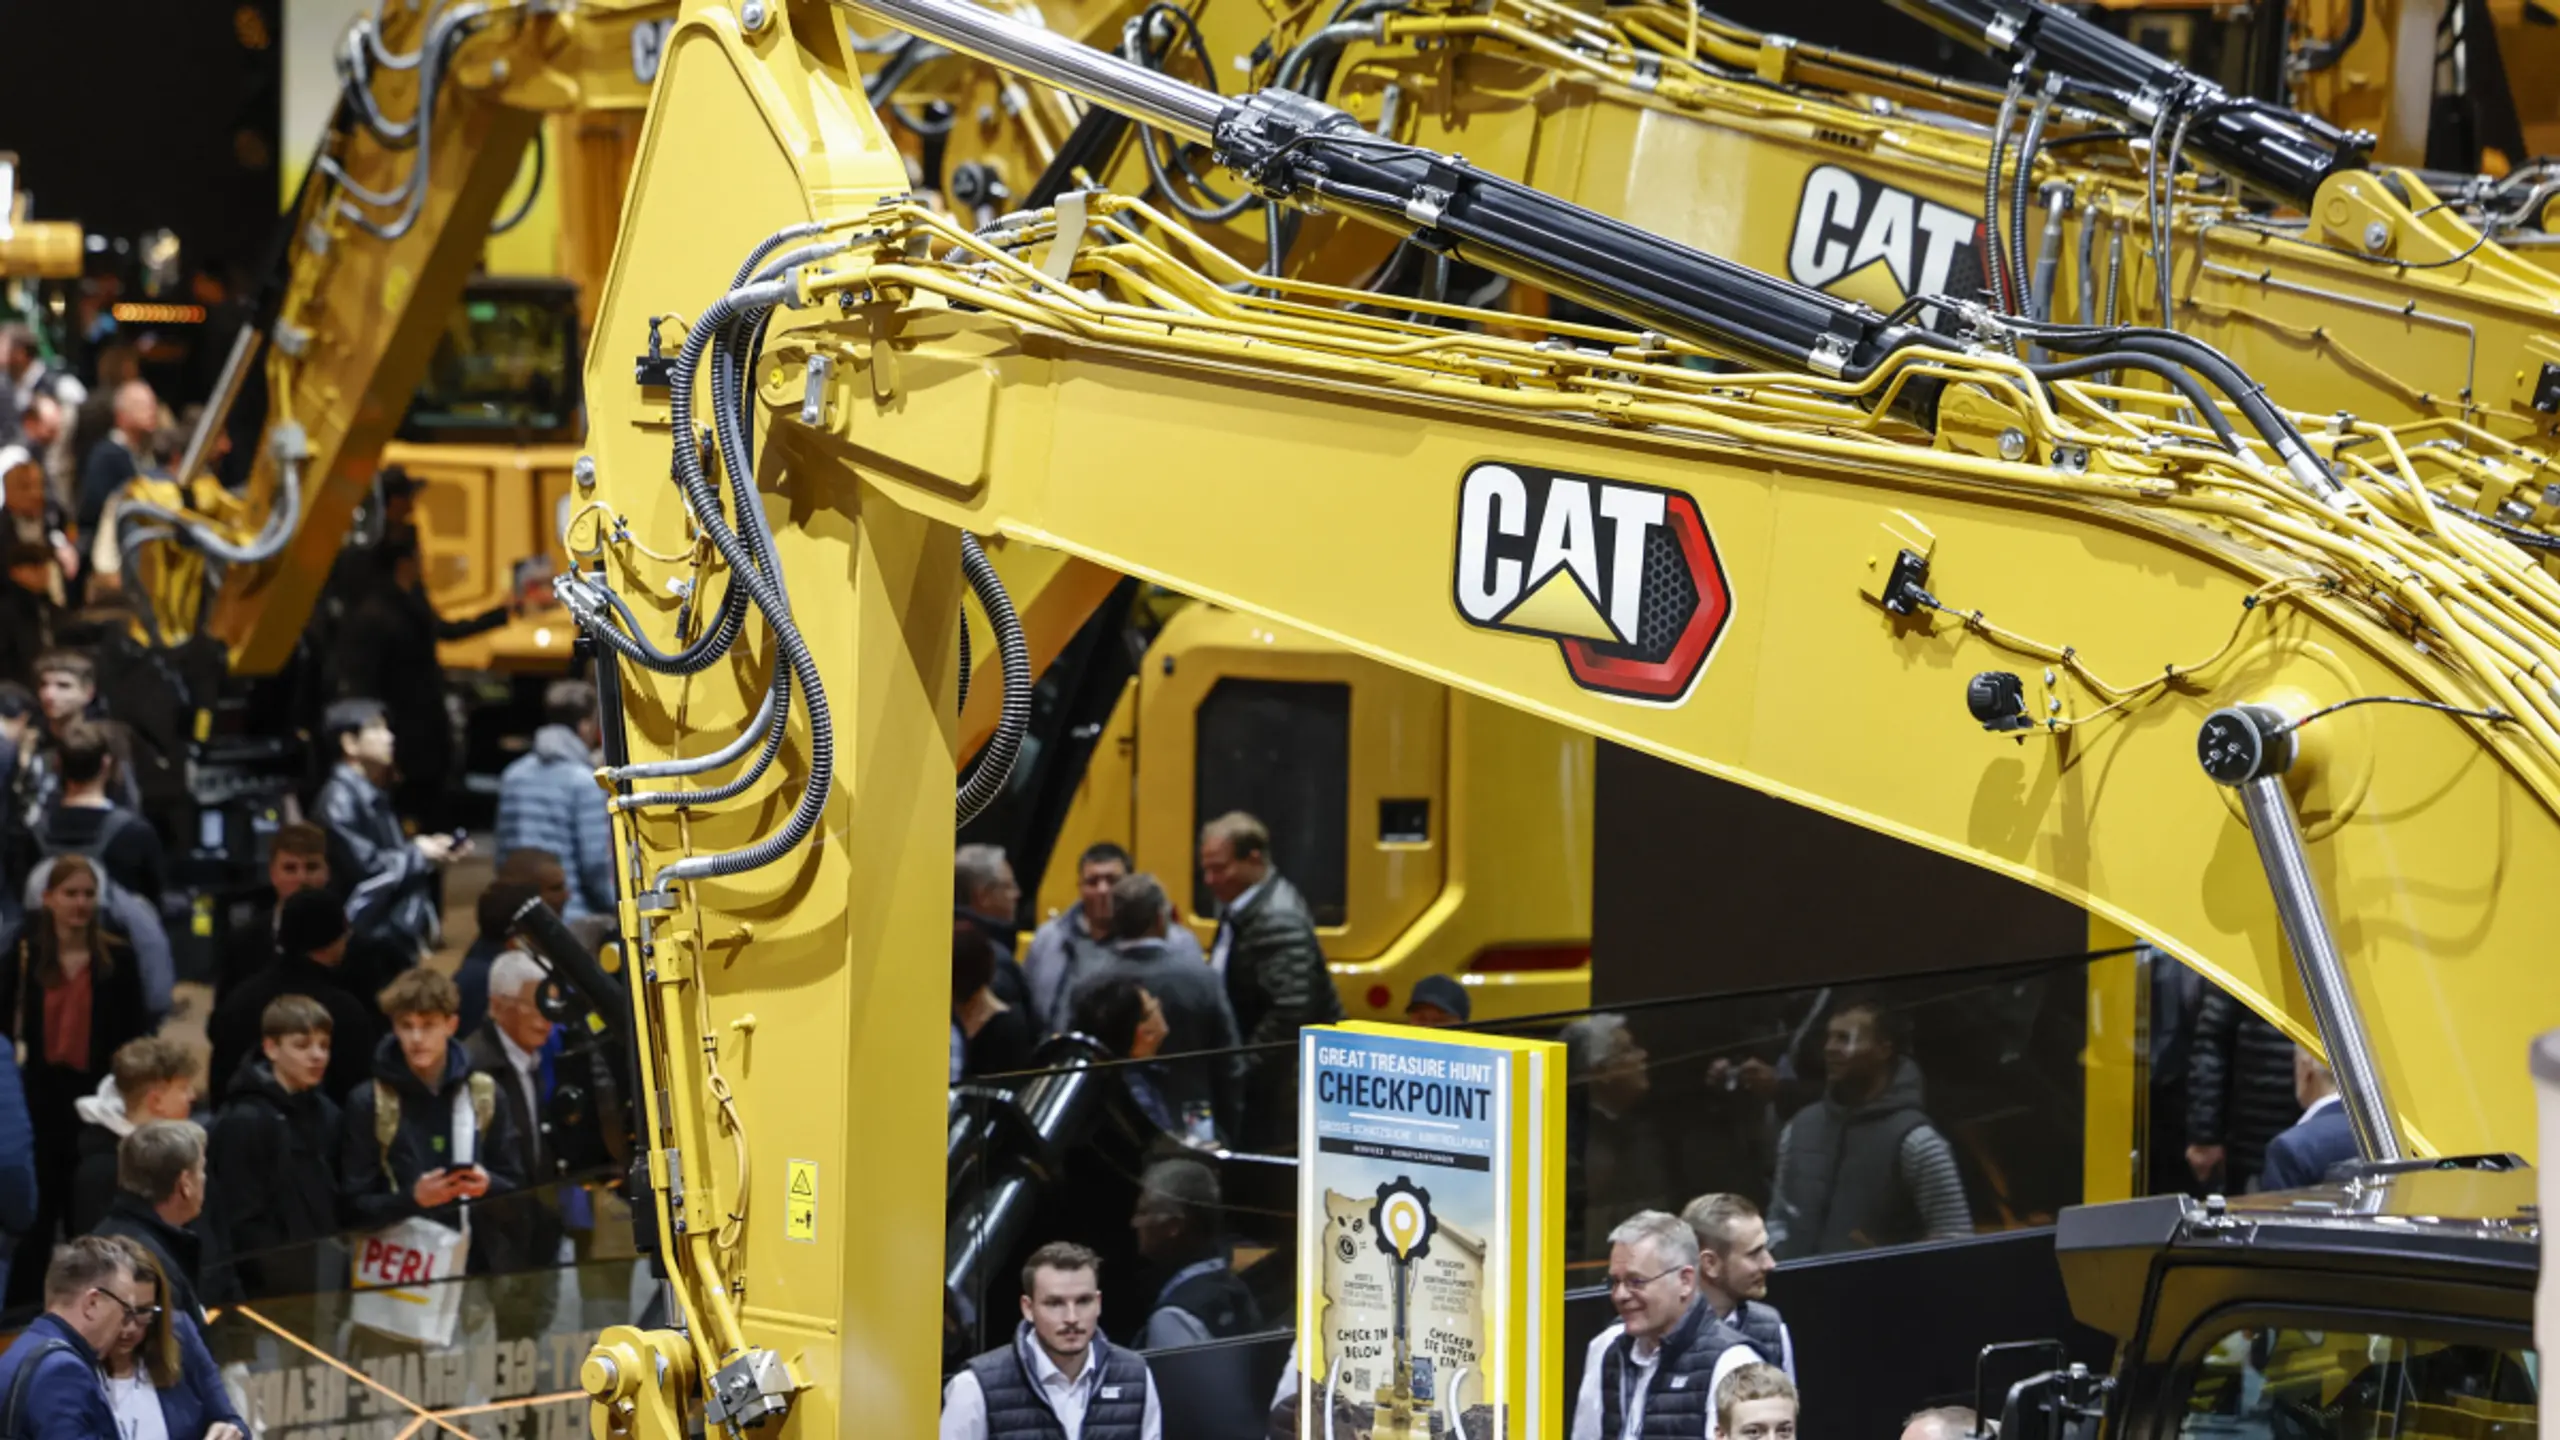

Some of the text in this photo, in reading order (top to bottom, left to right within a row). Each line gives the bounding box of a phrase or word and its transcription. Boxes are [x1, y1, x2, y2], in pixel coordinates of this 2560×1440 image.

[1790, 165, 1977, 330] CAT
[1458, 465, 1666, 645] CAT
[1318, 1047, 1492, 1083] GREAT TREASURE HUNT
[1319, 1070, 1491, 1121] CHECKPOINT
[363, 1236, 434, 1288] PERI
[1337, 1328, 1370, 1342] CHECK
[1344, 1346, 1382, 1359] BELOW
